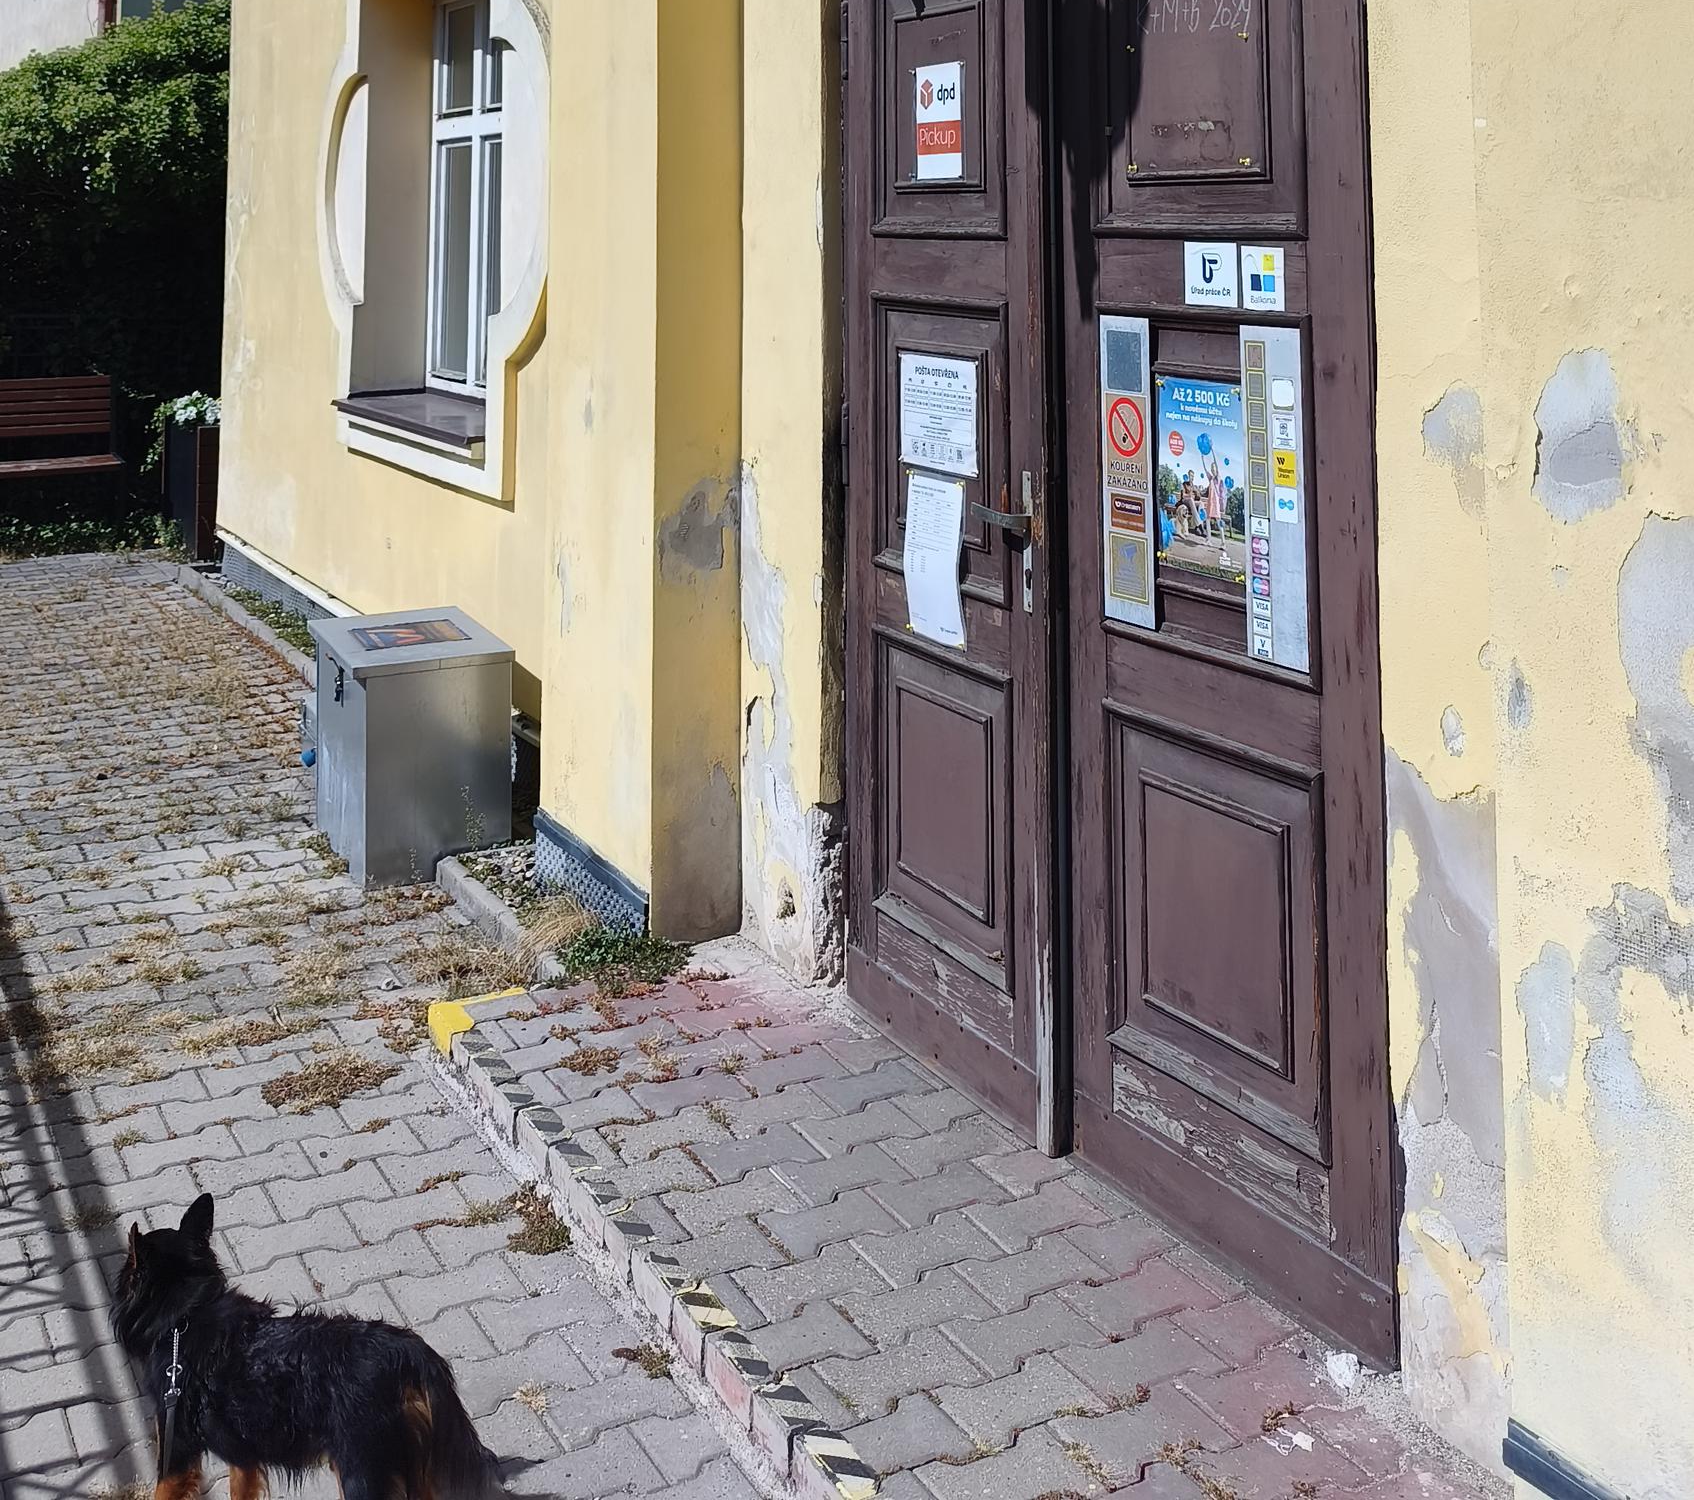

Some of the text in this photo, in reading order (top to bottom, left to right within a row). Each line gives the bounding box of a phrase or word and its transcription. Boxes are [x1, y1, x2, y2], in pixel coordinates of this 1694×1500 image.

[937, 82, 955, 105] dpd
[919, 126, 956, 148] Pickup
[1222, 287, 1231, 297] ČR
[914, 365, 931, 376] POŠTA
[1172, 387, 1231, 407] Až 2 500 Kč
[1165, 411, 1182, 421] nejen
[1255, 601, 1269, 612] VISA
[1256, 620, 1269, 631] VISA
